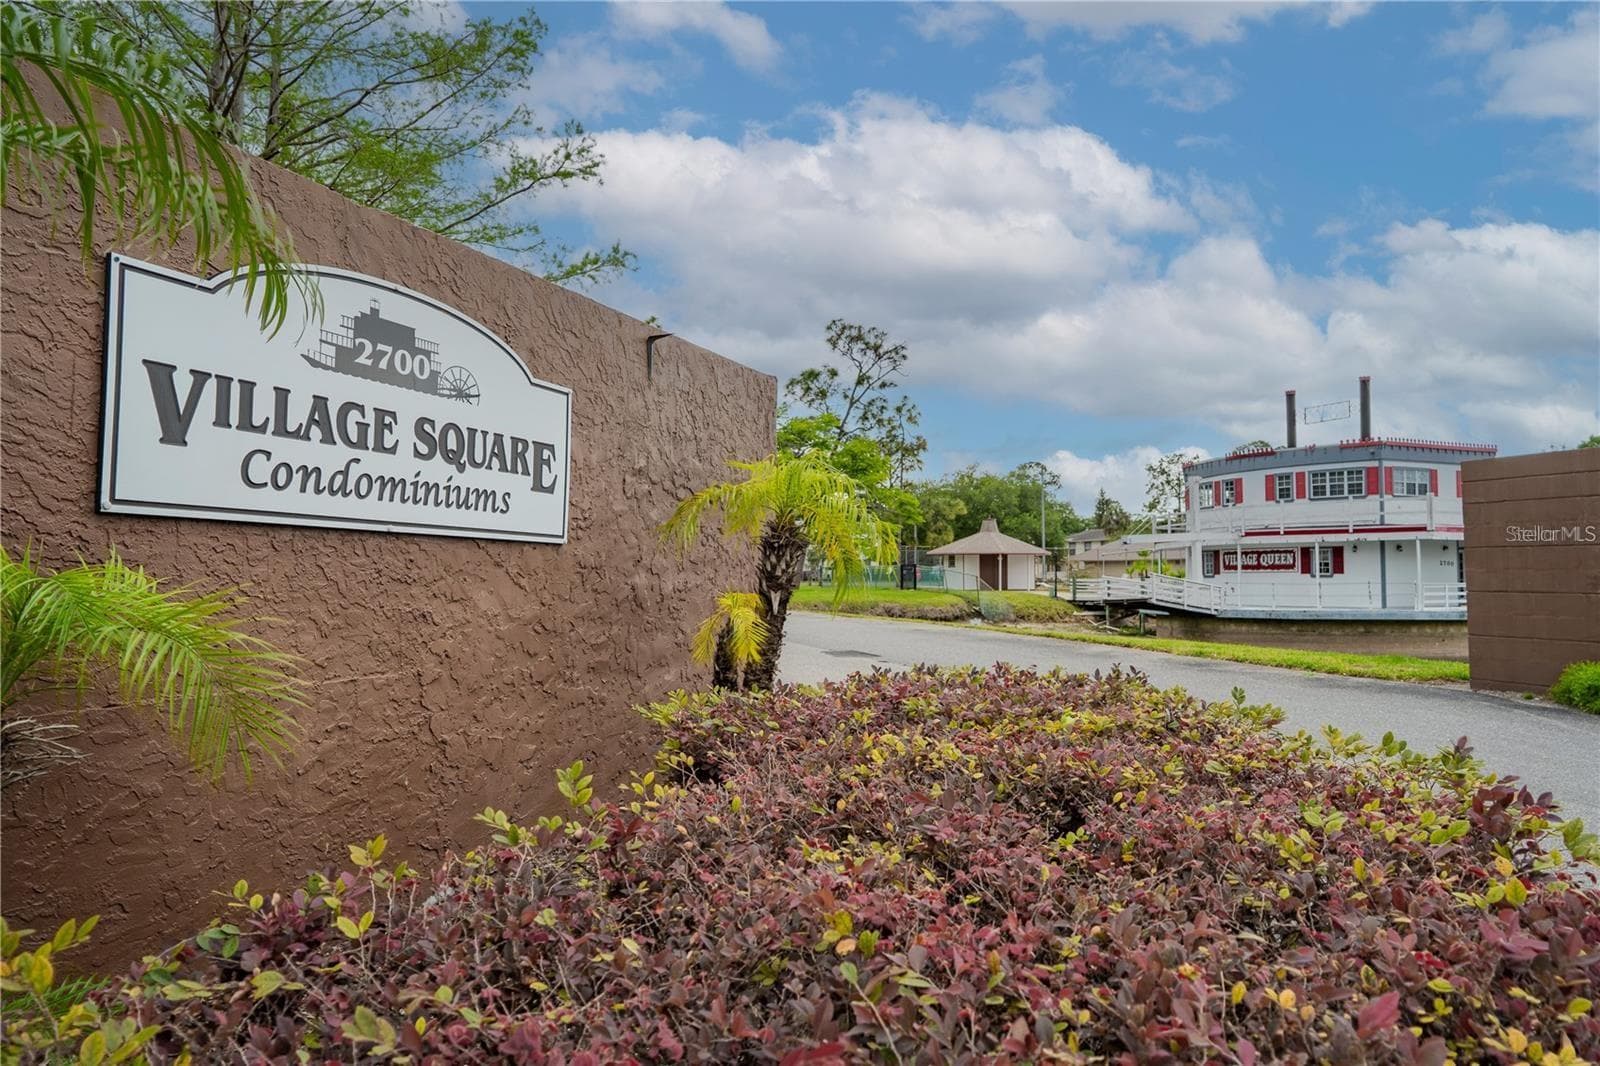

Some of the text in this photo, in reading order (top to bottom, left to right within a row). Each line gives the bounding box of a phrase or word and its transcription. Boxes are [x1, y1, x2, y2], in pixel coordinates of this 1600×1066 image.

[354, 337, 431, 380] 2700
[142, 359, 558, 495] VILLAGE SQUARE
[240, 448, 511, 514] Condominiums
[1224, 553, 1294, 566] VILAGE QUEEN
